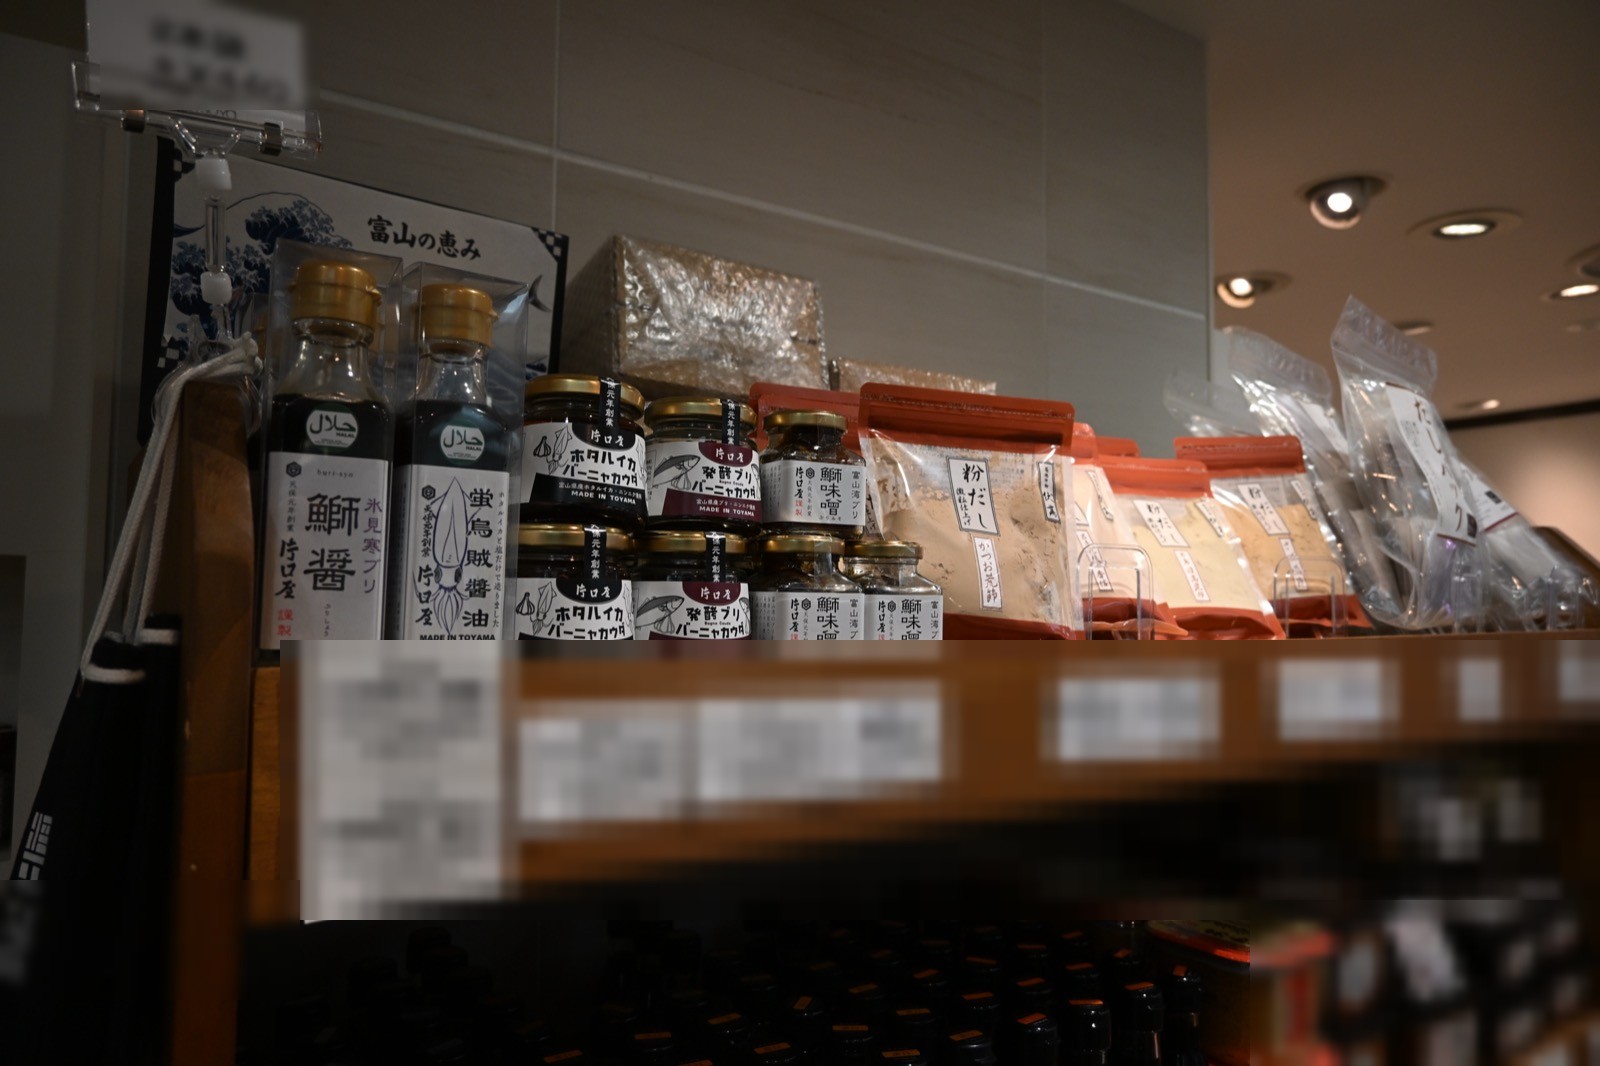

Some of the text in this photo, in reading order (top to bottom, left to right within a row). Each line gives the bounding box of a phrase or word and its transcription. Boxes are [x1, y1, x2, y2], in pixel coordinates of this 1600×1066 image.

[367, 214, 482, 260] 富山の恵み
[309, 413, 357, 434] حلال
[443, 428, 483, 448] حلال
[591, 429, 624, 447] 片口屋
[570, 449, 637, 472] ホタルイカ
[715, 447, 744, 463] 片口屋
[563, 464, 638, 487] バーニャカウダ
[702, 466, 752, 485] 発酵ブリ
[795, 467, 804, 499] 片口屋
[571, 490, 595, 499] MADE
[609, 494, 636, 505] TOYAMA
[692, 479, 756, 499] バーニャカウダ
[820, 466, 842, 516] 鰤味噌
[851, 471, 861, 520] 富山湾ブリ
[962, 463, 988, 530] 粉だし
[699, 505, 720, 513] MADE
[733, 508, 755, 517] TOYAMA
[303, 493, 361, 592] 鰤醤
[362, 497, 383, 594] 氷見寒ブリ
[275, 537, 299, 599] 片口屋
[415, 564, 434, 626] 片口屋
[576, 583, 611, 598] 片口屋
[700, 587, 732, 600] 片口屋
[555, 606, 624, 622] ホタルイカ
[686, 606, 740, 621] 発酵ブリ
[789, 598, 800, 633] 片口屋
[877, 600, 886, 634] 片口屋
[548, 622, 626, 640] バーニャカウダ
[676, 622, 745, 639] バーニャカウダ
